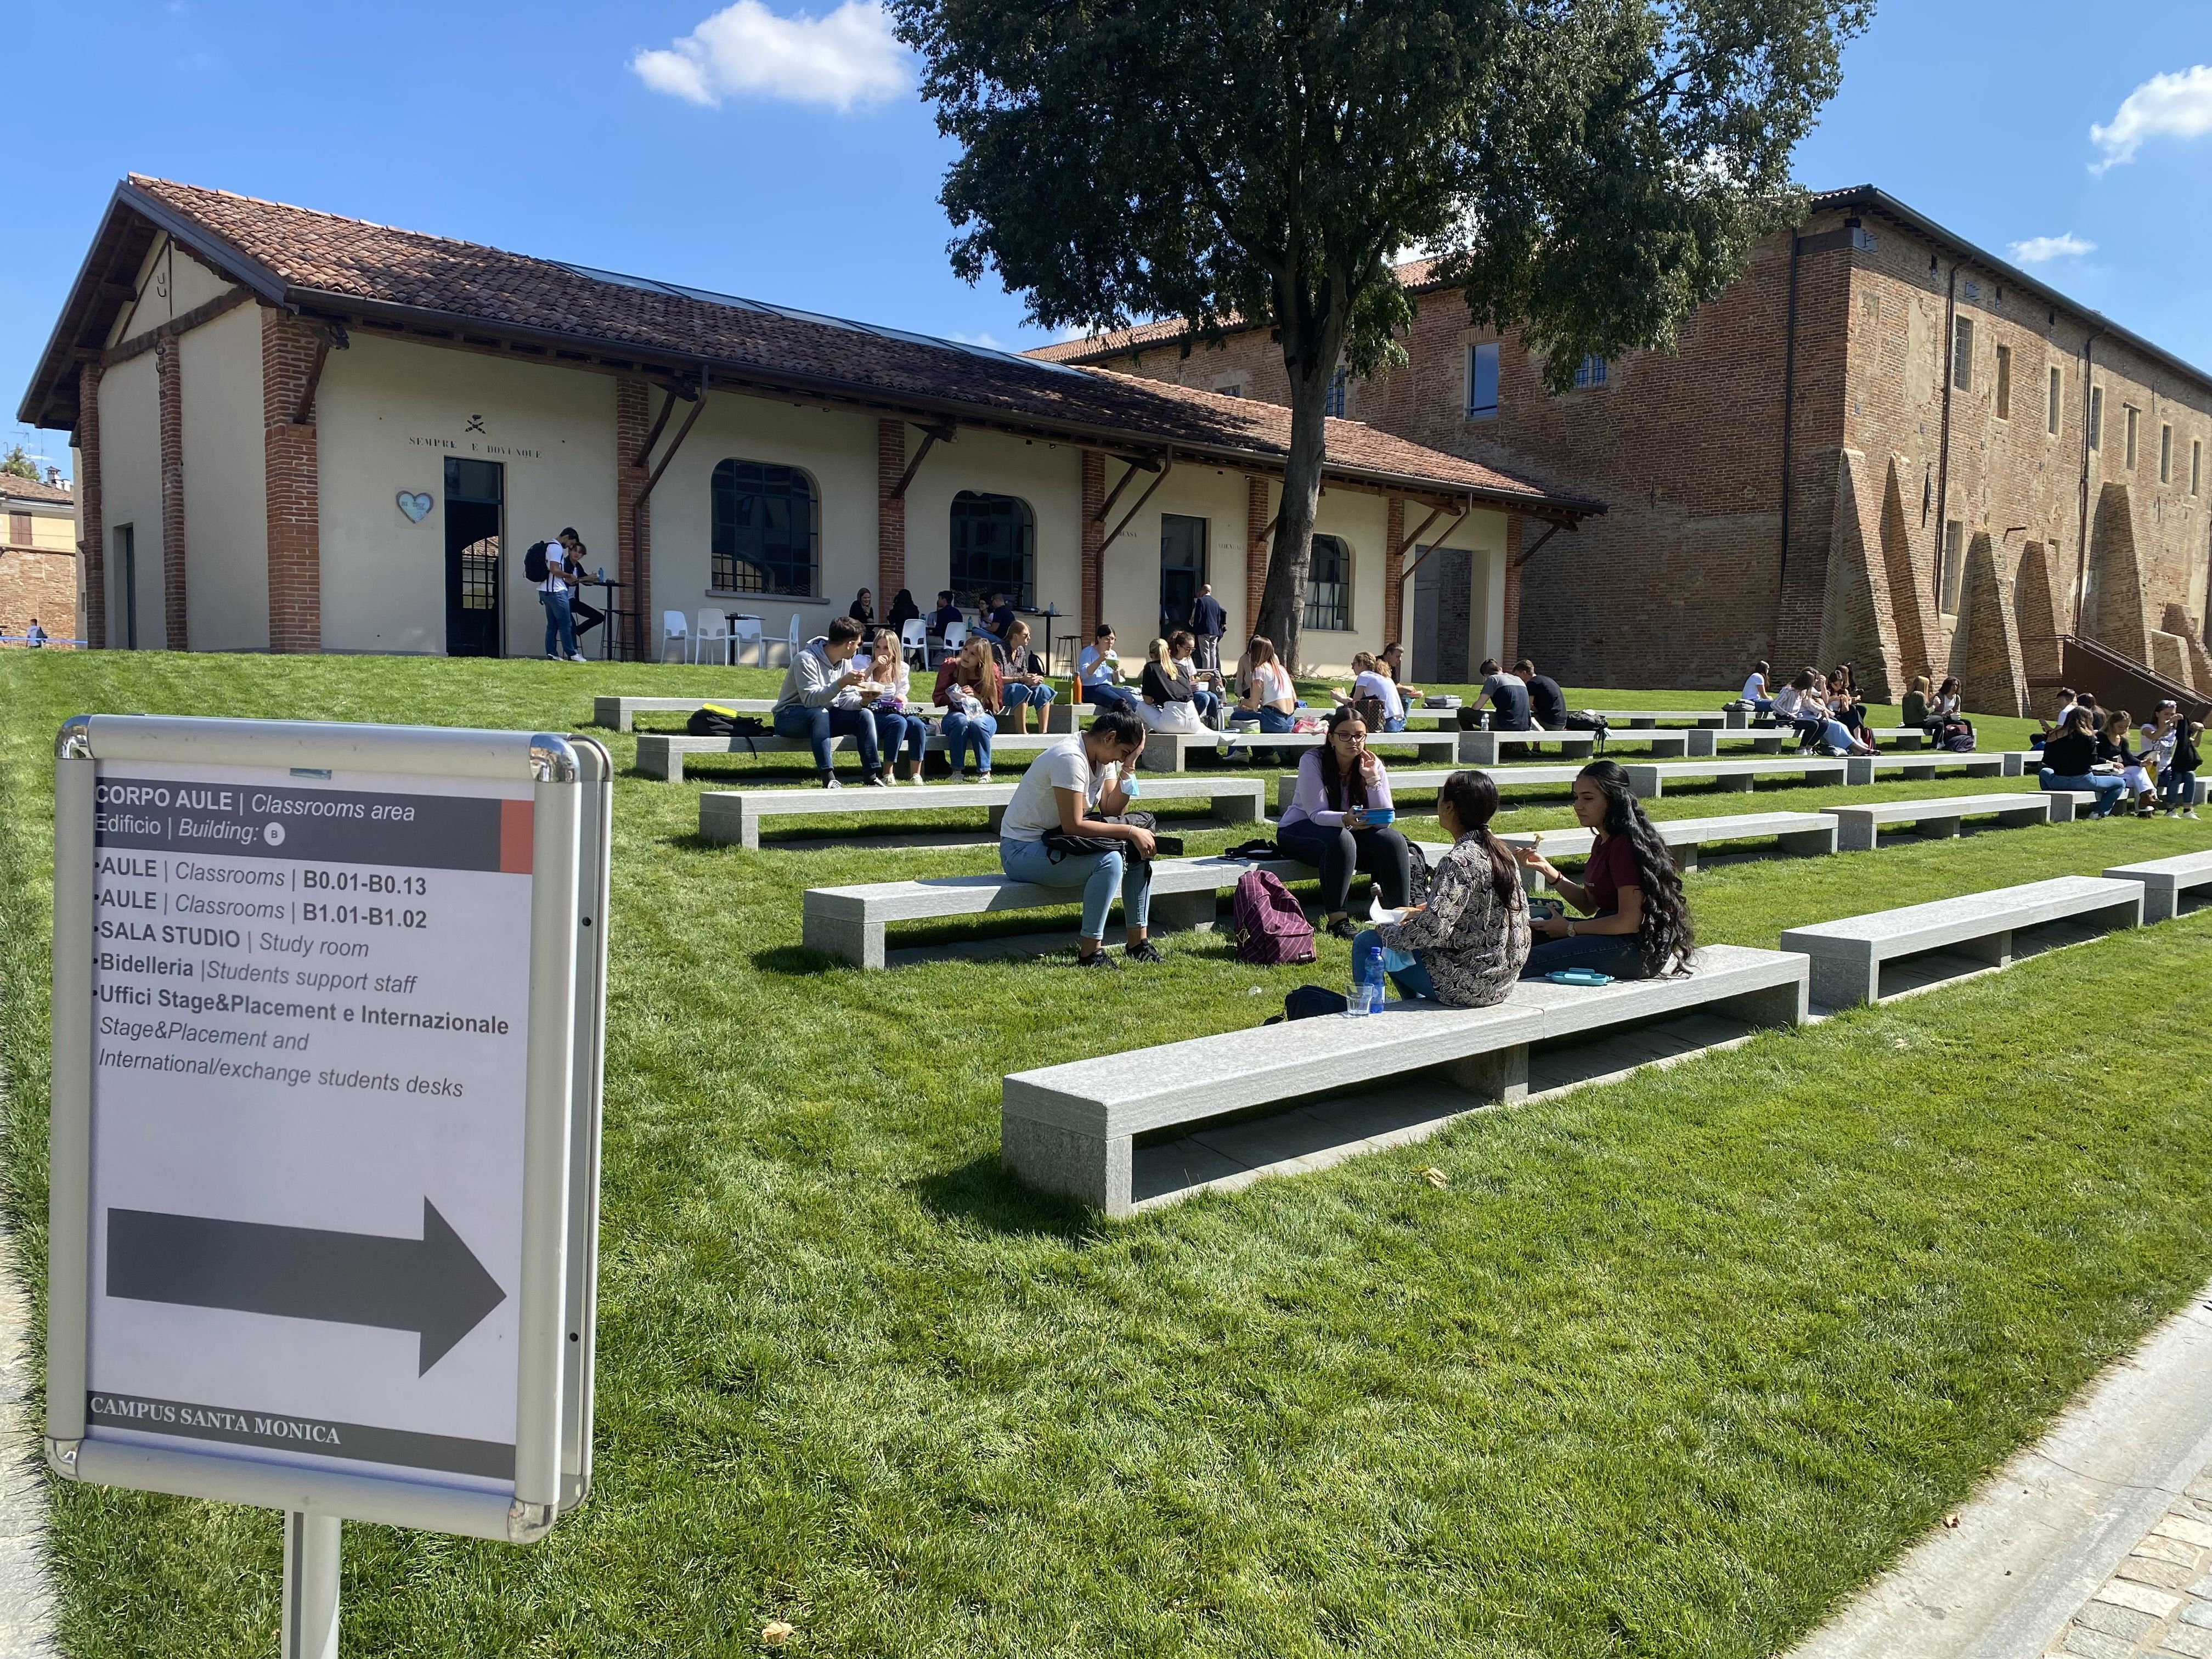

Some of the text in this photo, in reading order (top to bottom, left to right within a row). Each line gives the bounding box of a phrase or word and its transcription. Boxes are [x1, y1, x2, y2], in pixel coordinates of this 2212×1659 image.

[409, 437, 457, 449] SEMPRE
[472, 443, 478, 451] E
[96, 785, 170, 807] CORPO
[175, 789, 233, 811] AULE
[252, 794, 365, 819] Classrooms
[370, 805, 415, 821] area
[95, 813, 161, 834] Edificio
[178, 817, 259, 845] Building:
[176, 862, 285, 887] Classrooms
[303, 870, 427, 896] B0.01-B0.13
[176, 894, 285, 919] Classrooms
[303, 902, 427, 928] B1.01-B1.02
[162, 925, 240, 947] STUDIO
[259, 933, 314, 958] Study
[319, 940, 370, 957] room
[296, 971, 369, 991] support
[374, 975, 418, 994] staff
[158, 989, 337, 1021] Stage&Placement
[343, 1008, 354, 1022] e
[362, 1005, 509, 1035] Internazionale
[99, 1016, 309, 1051] Stage&Placement and
[99, 1048, 464, 1098] International/exchange students desks
[90, 1397, 341, 1444] CAMPUS SANTA MONICA
